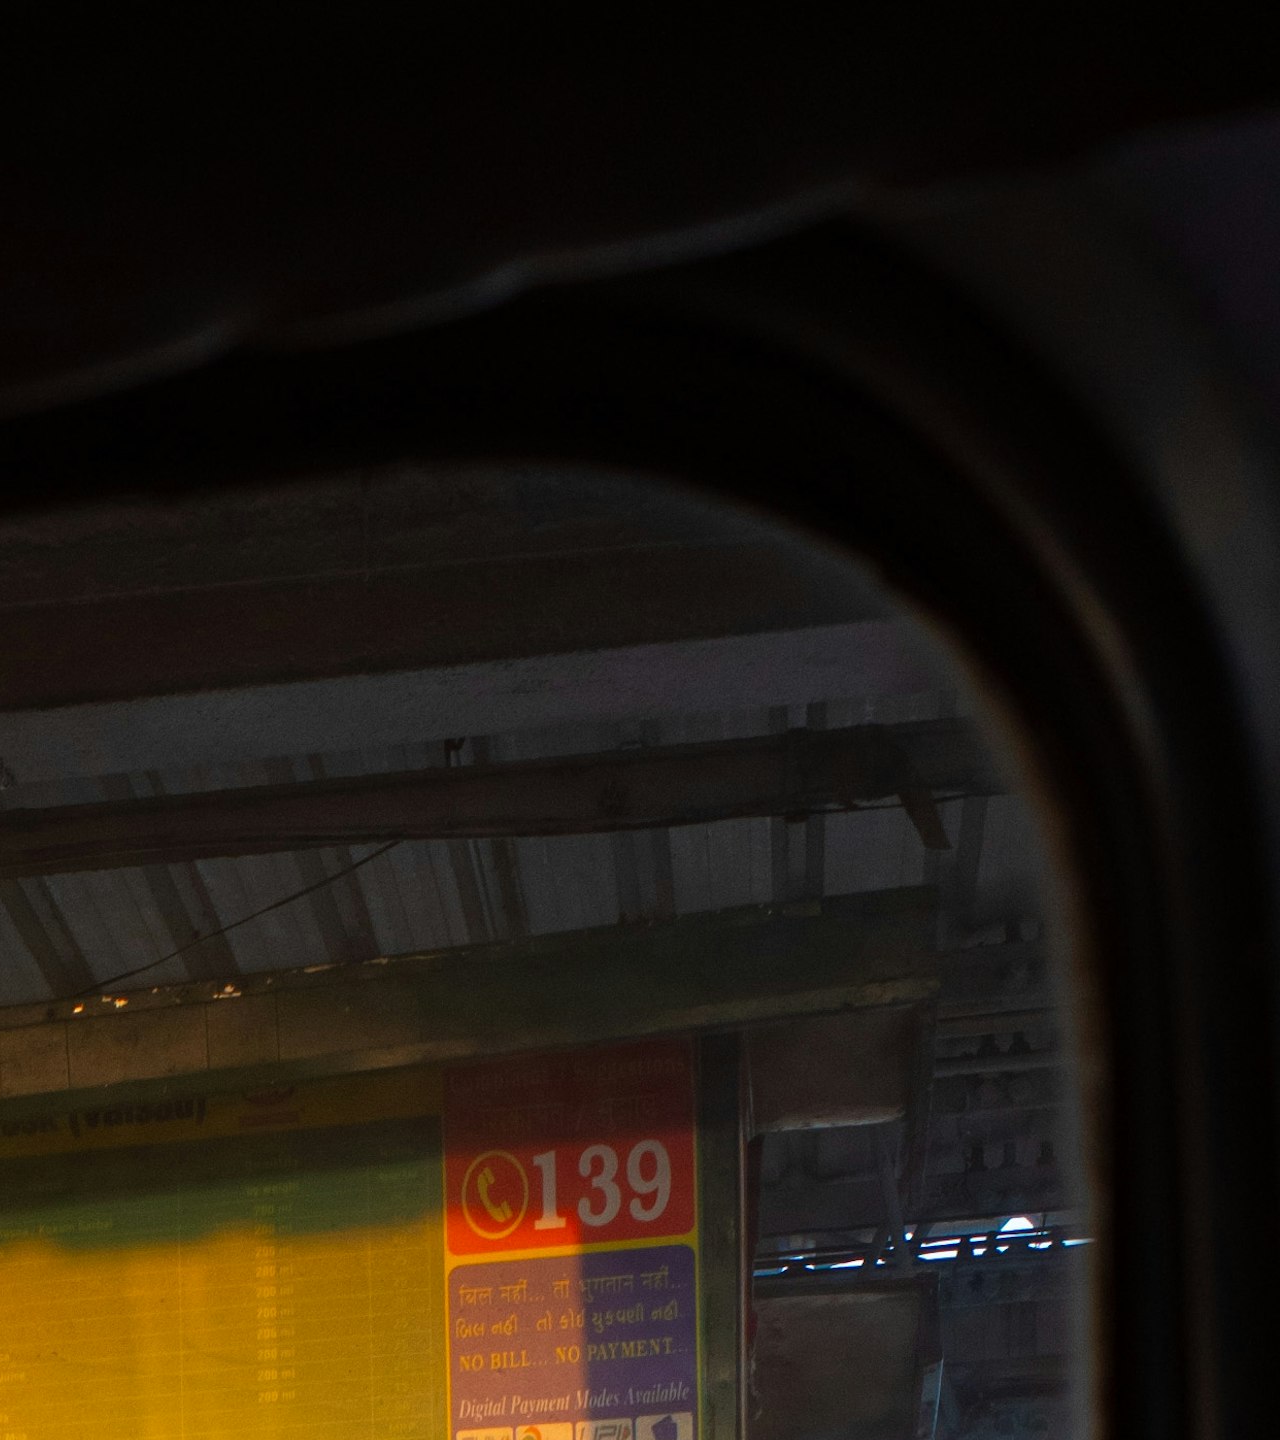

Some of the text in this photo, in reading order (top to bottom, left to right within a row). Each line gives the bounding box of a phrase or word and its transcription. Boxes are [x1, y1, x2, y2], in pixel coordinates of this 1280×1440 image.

[533, 1139, 671, 1230] 139
[458, 1348, 580, 1371] NO NO
[458, 1381, 690, 1424] Digital Payment Modes Available
